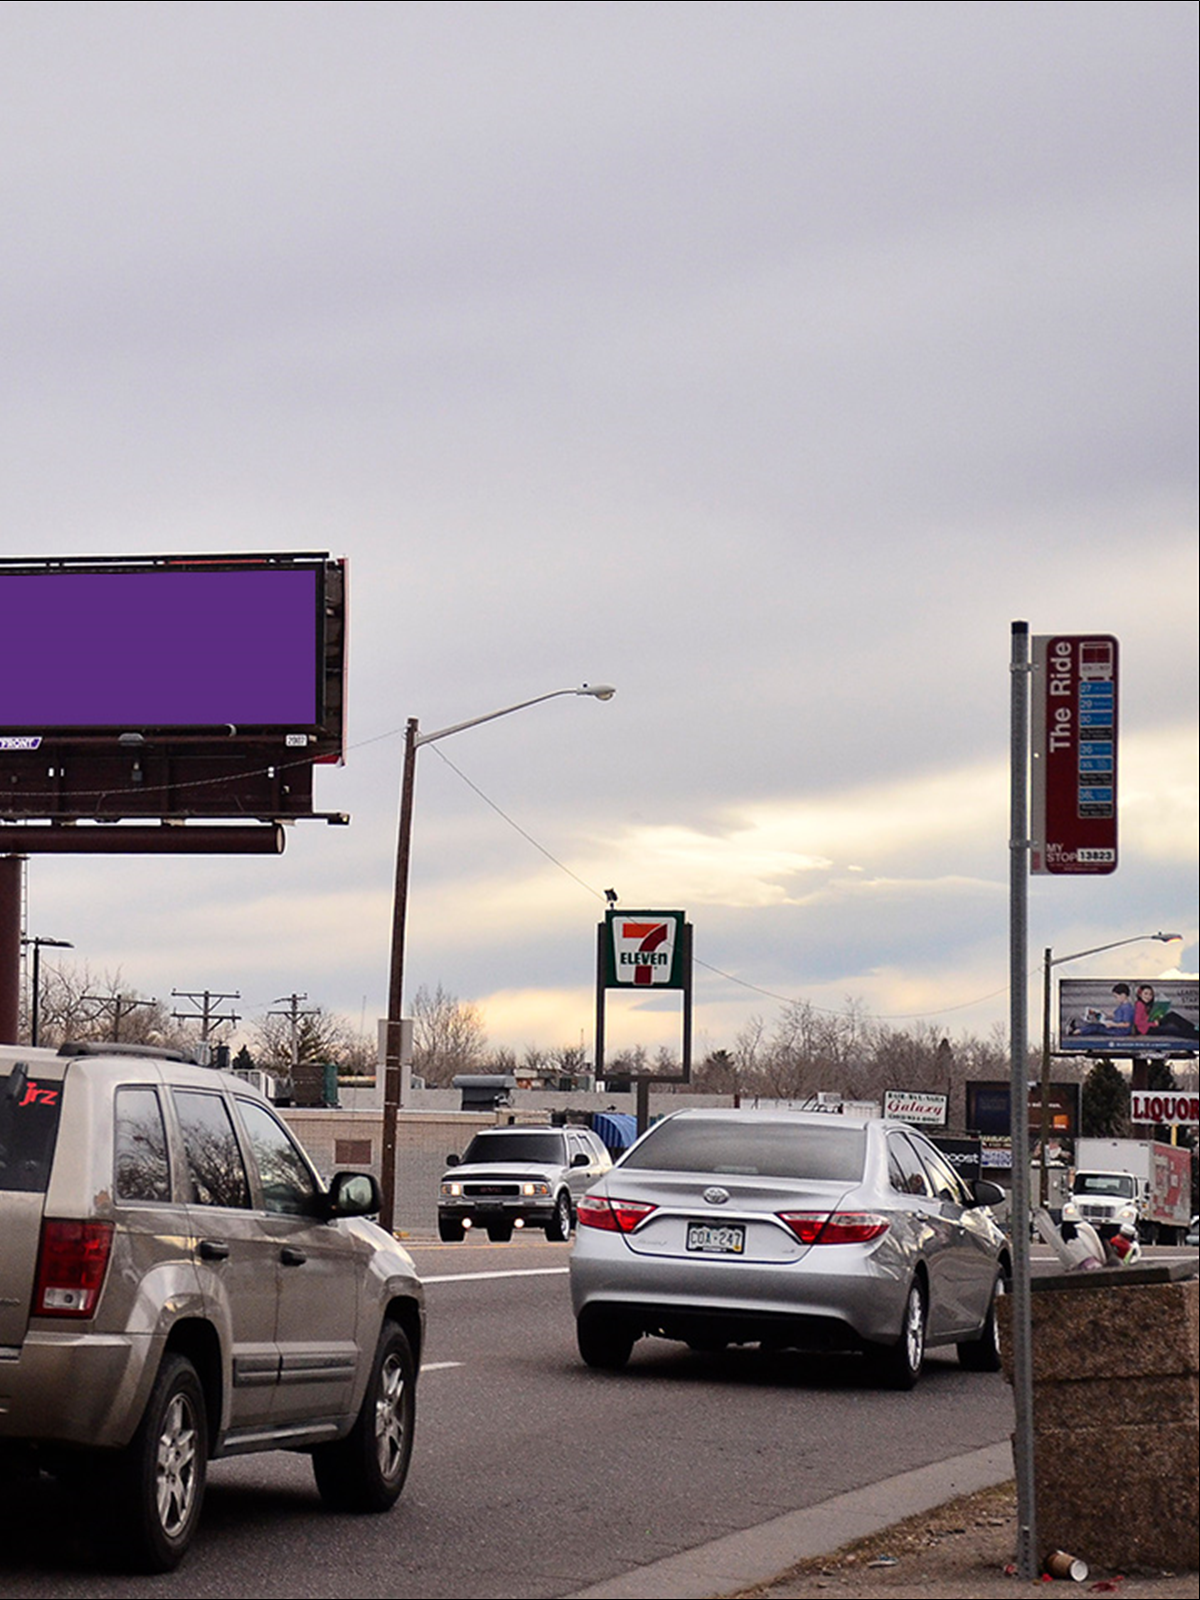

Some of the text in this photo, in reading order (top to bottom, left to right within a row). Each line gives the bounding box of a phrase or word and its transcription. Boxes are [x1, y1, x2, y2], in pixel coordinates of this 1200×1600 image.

[1050, 641, 1072, 752] The Ride
[1046, 843, 1064, 852] MY
[1046, 852, 1078, 863] STOP
[1080, 851, 1113, 860] 13823
[622, 922, 668, 985] 7
[887, 1100, 942, 1116] Galaxy
